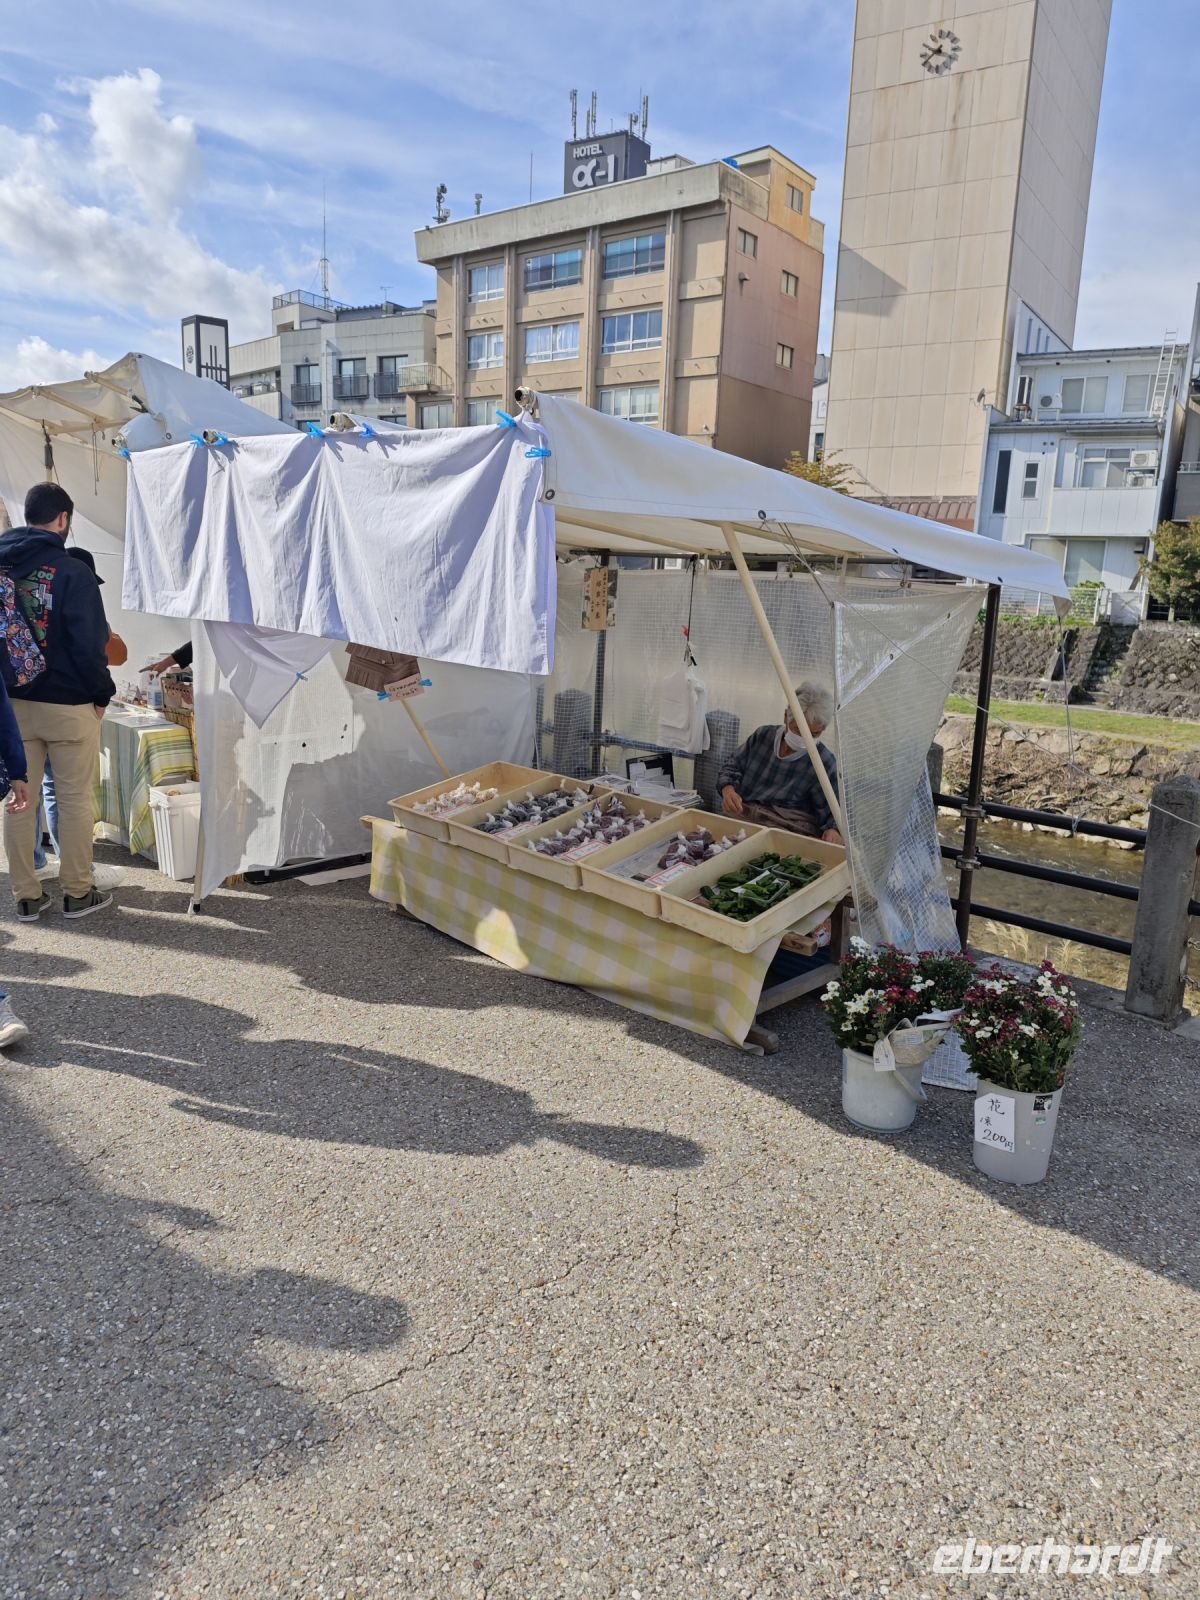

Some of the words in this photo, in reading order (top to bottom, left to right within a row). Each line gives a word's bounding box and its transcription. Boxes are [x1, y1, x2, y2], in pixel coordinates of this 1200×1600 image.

[573, 144, 602, 158] HOTEL
[987, 1098, 1005, 1115] 花
[982, 1129, 1014, 1151] 200円
